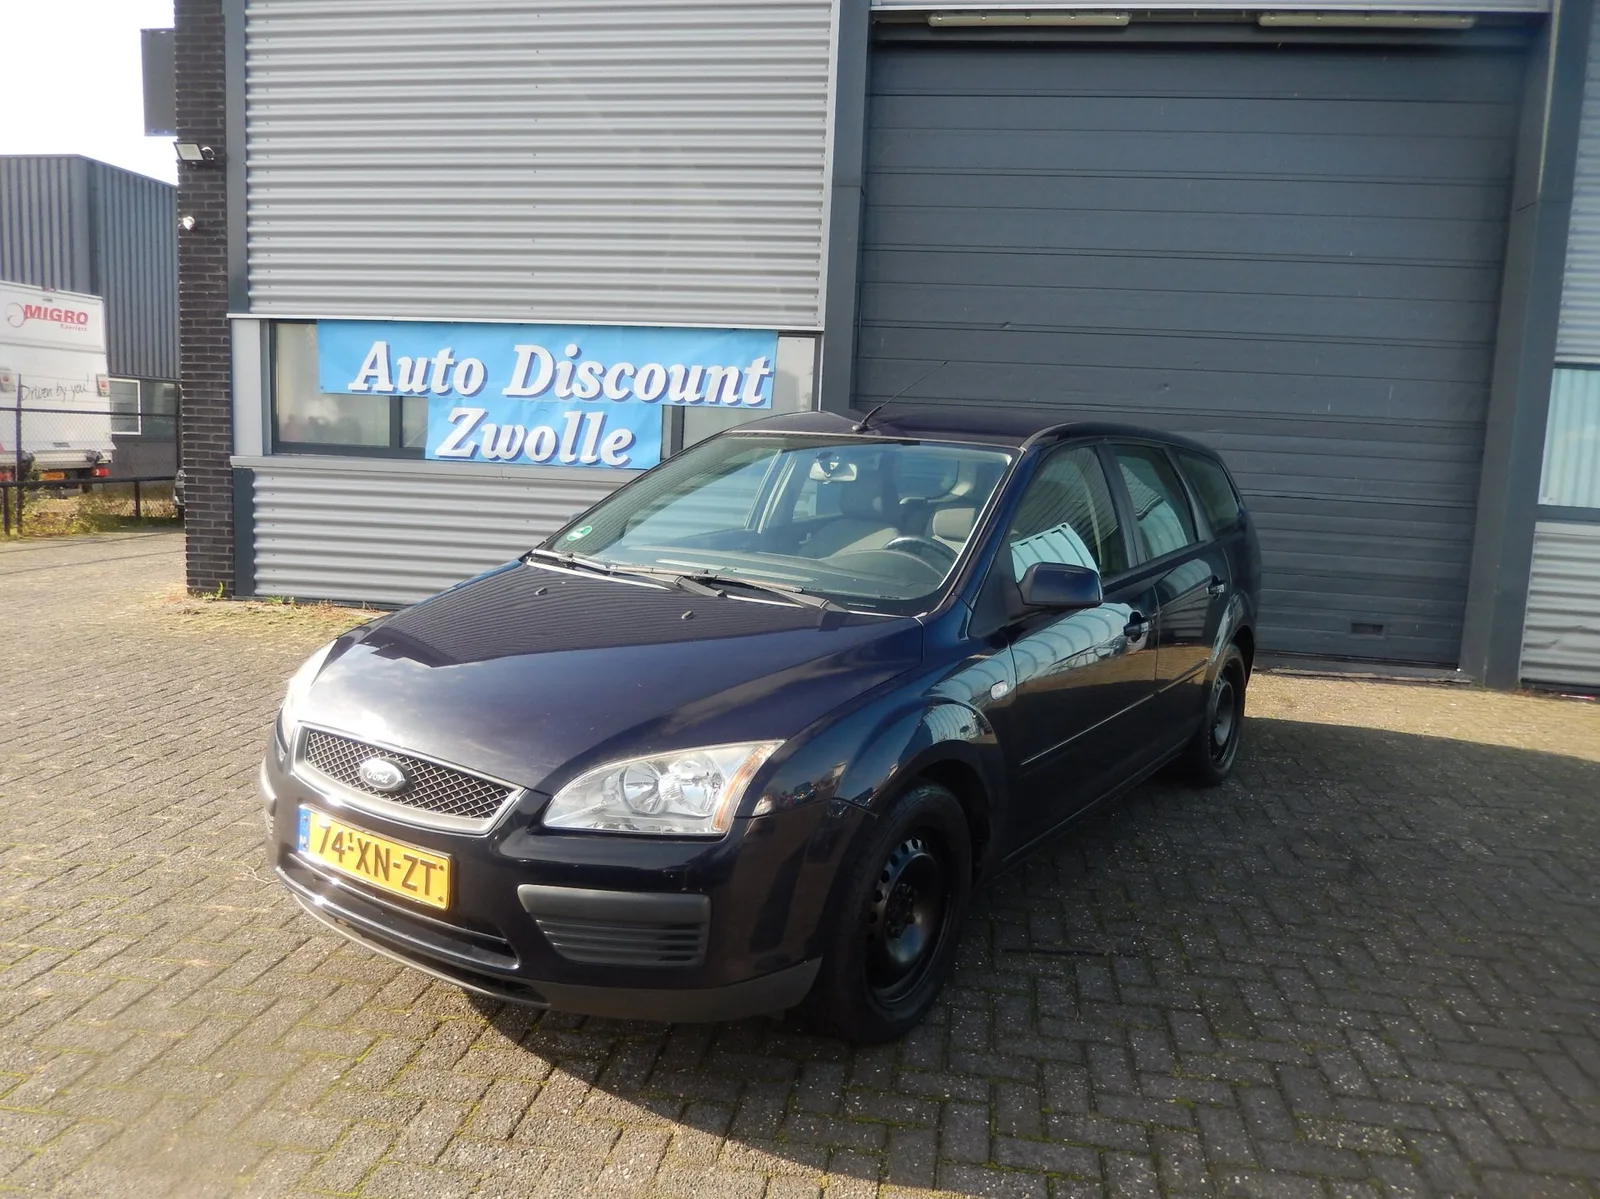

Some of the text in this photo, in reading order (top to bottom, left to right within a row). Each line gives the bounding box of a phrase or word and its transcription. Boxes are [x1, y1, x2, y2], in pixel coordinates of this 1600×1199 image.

[24, 304, 89, 325] MIGRO
[20, 383, 53, 402] Driven
[56, 381, 67, 404] by
[347, 340, 772, 405] Auto Discount
[434, 406, 636, 467] Zwolle
